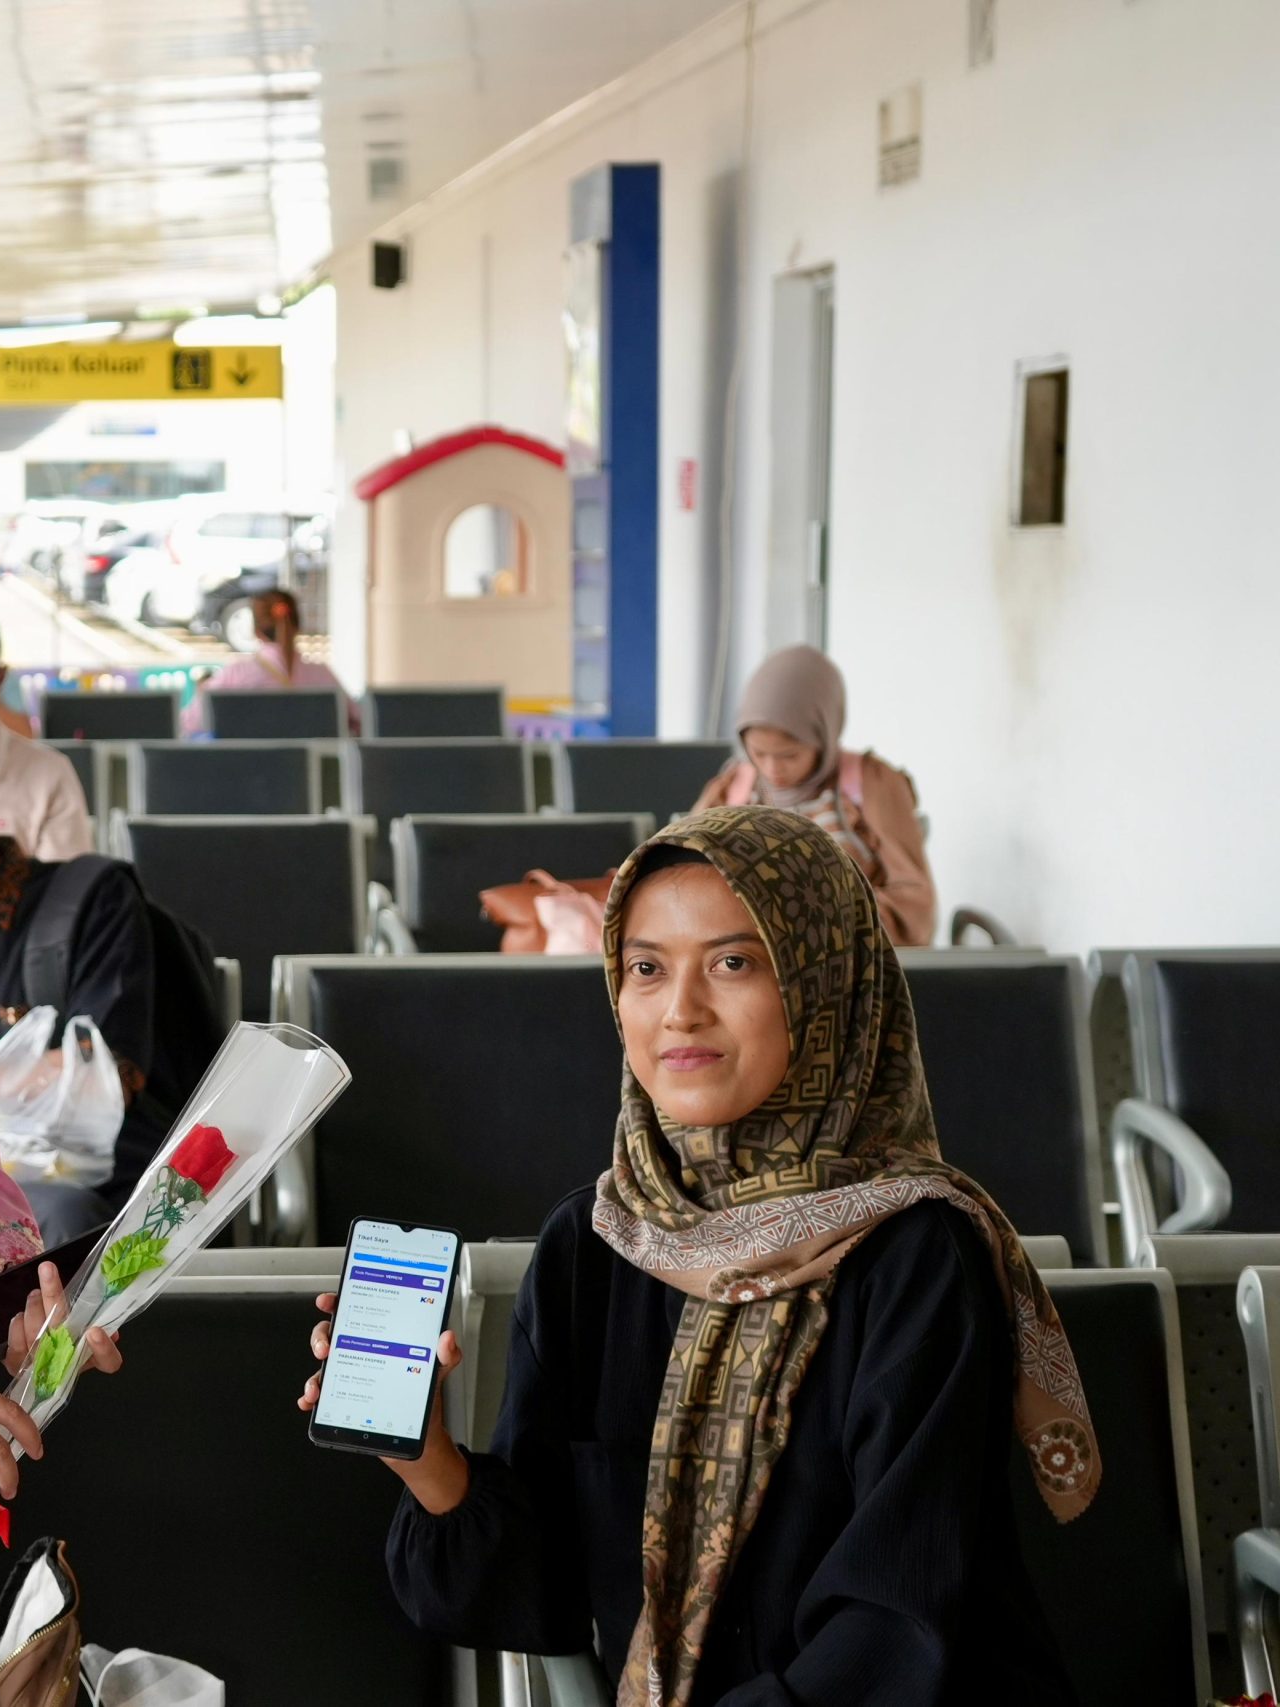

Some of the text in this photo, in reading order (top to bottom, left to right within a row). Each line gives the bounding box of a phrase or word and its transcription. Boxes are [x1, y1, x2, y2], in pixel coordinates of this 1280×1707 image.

[0, 351, 145, 375] Pintu Keluar
[358, 1234, 389, 1244] Tiket Saya
